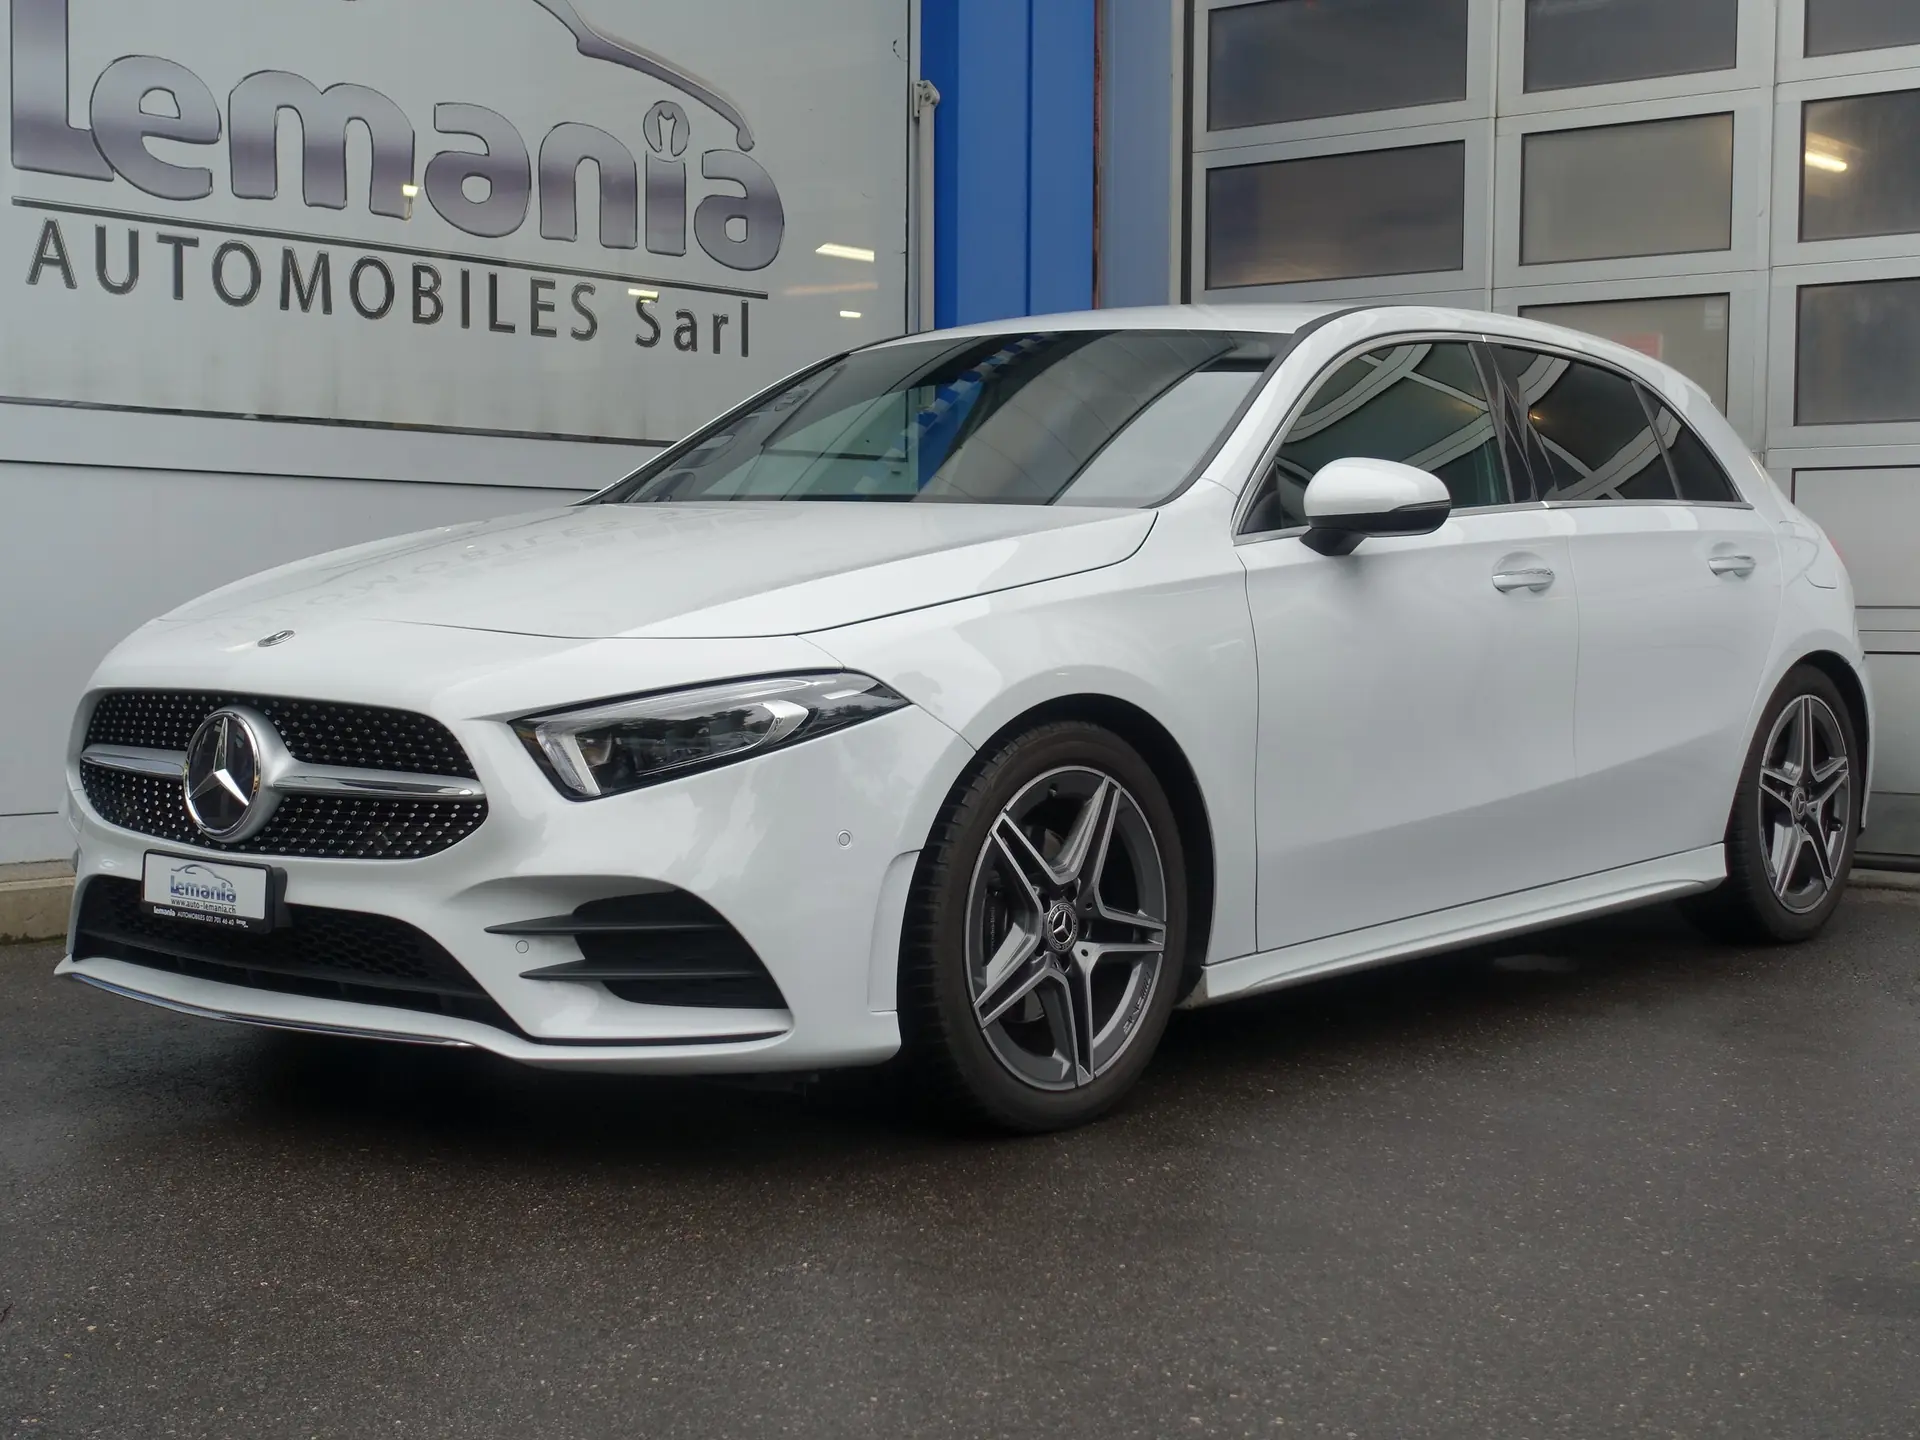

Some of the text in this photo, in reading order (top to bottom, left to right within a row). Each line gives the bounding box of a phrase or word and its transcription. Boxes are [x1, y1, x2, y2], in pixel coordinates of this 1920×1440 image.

[11, 0, 785, 271] Lemania
[26, 217, 749, 357] AUTOMOBILES Sarl
[170, 875, 237, 903] Lemania
[171, 899, 237, 915] www.auto-lemania.ch
